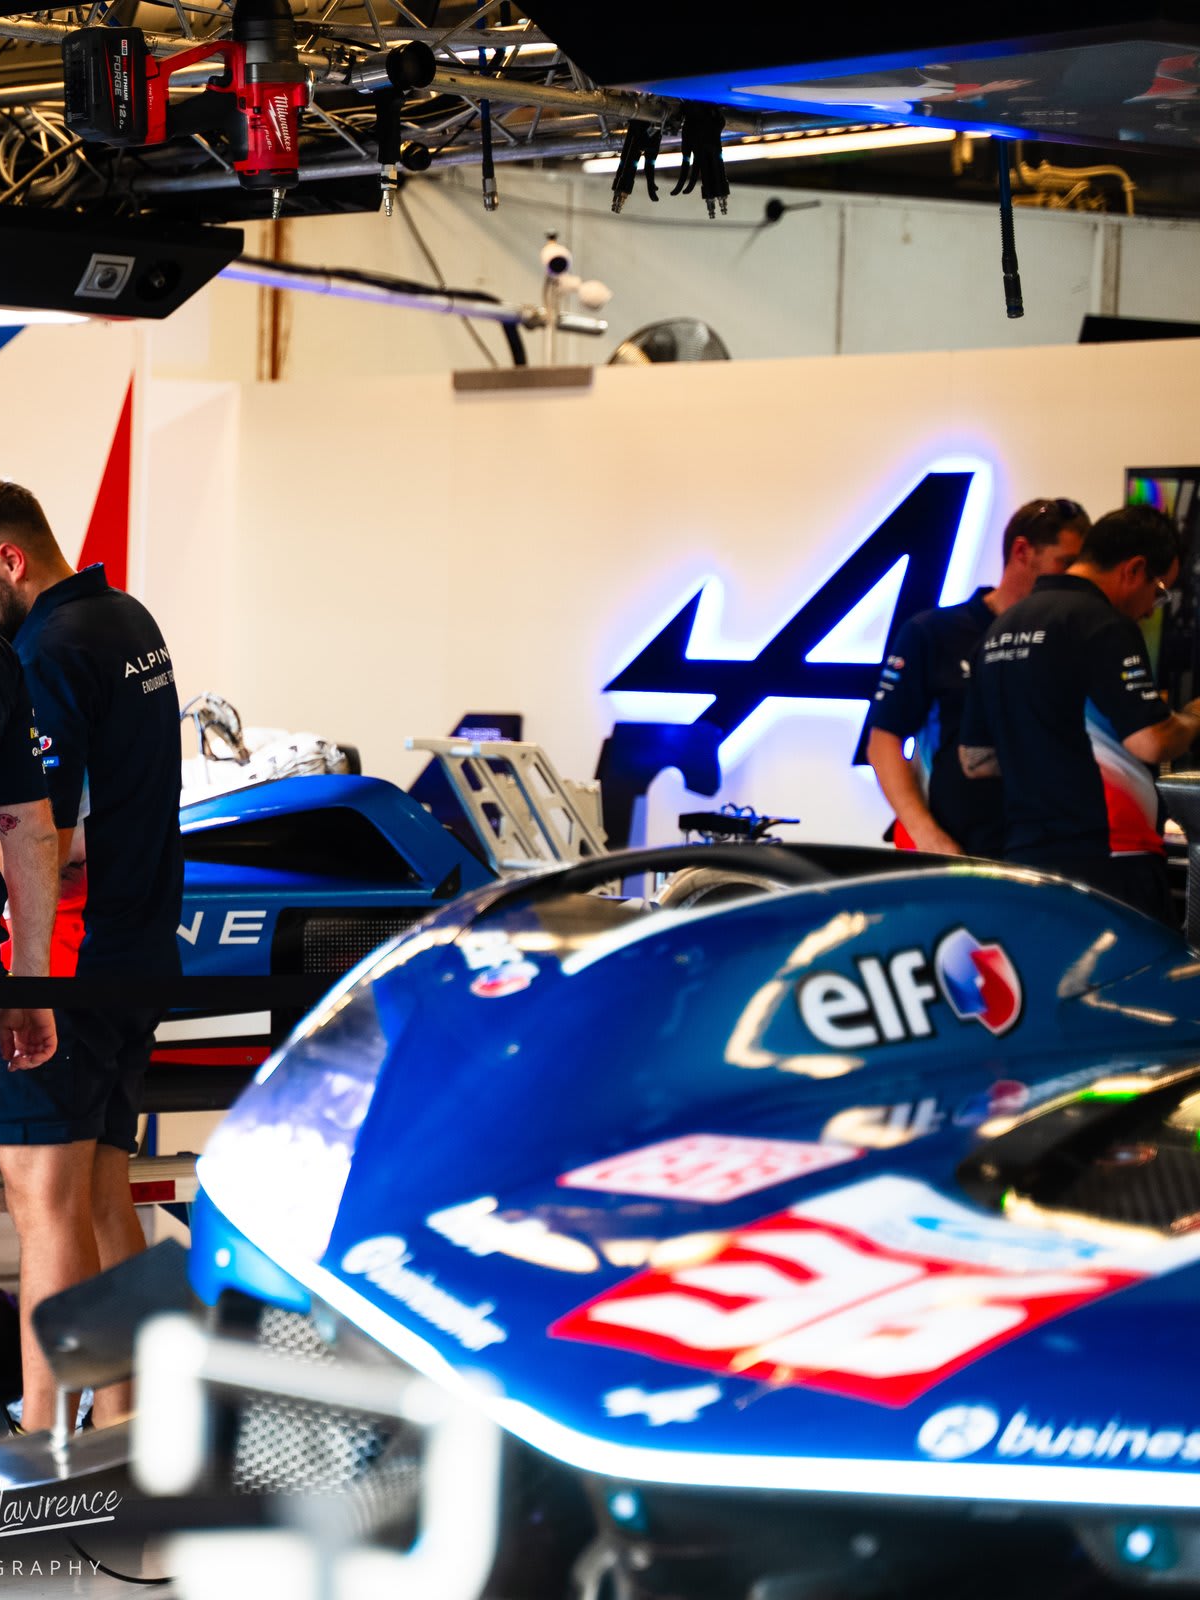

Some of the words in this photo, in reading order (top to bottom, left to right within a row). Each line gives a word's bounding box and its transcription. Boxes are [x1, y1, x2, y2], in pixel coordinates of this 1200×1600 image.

[113, 55, 122, 97] FORGE
[273, 93, 292, 152] Milwaukee
[800, 951, 934, 1046] elf
